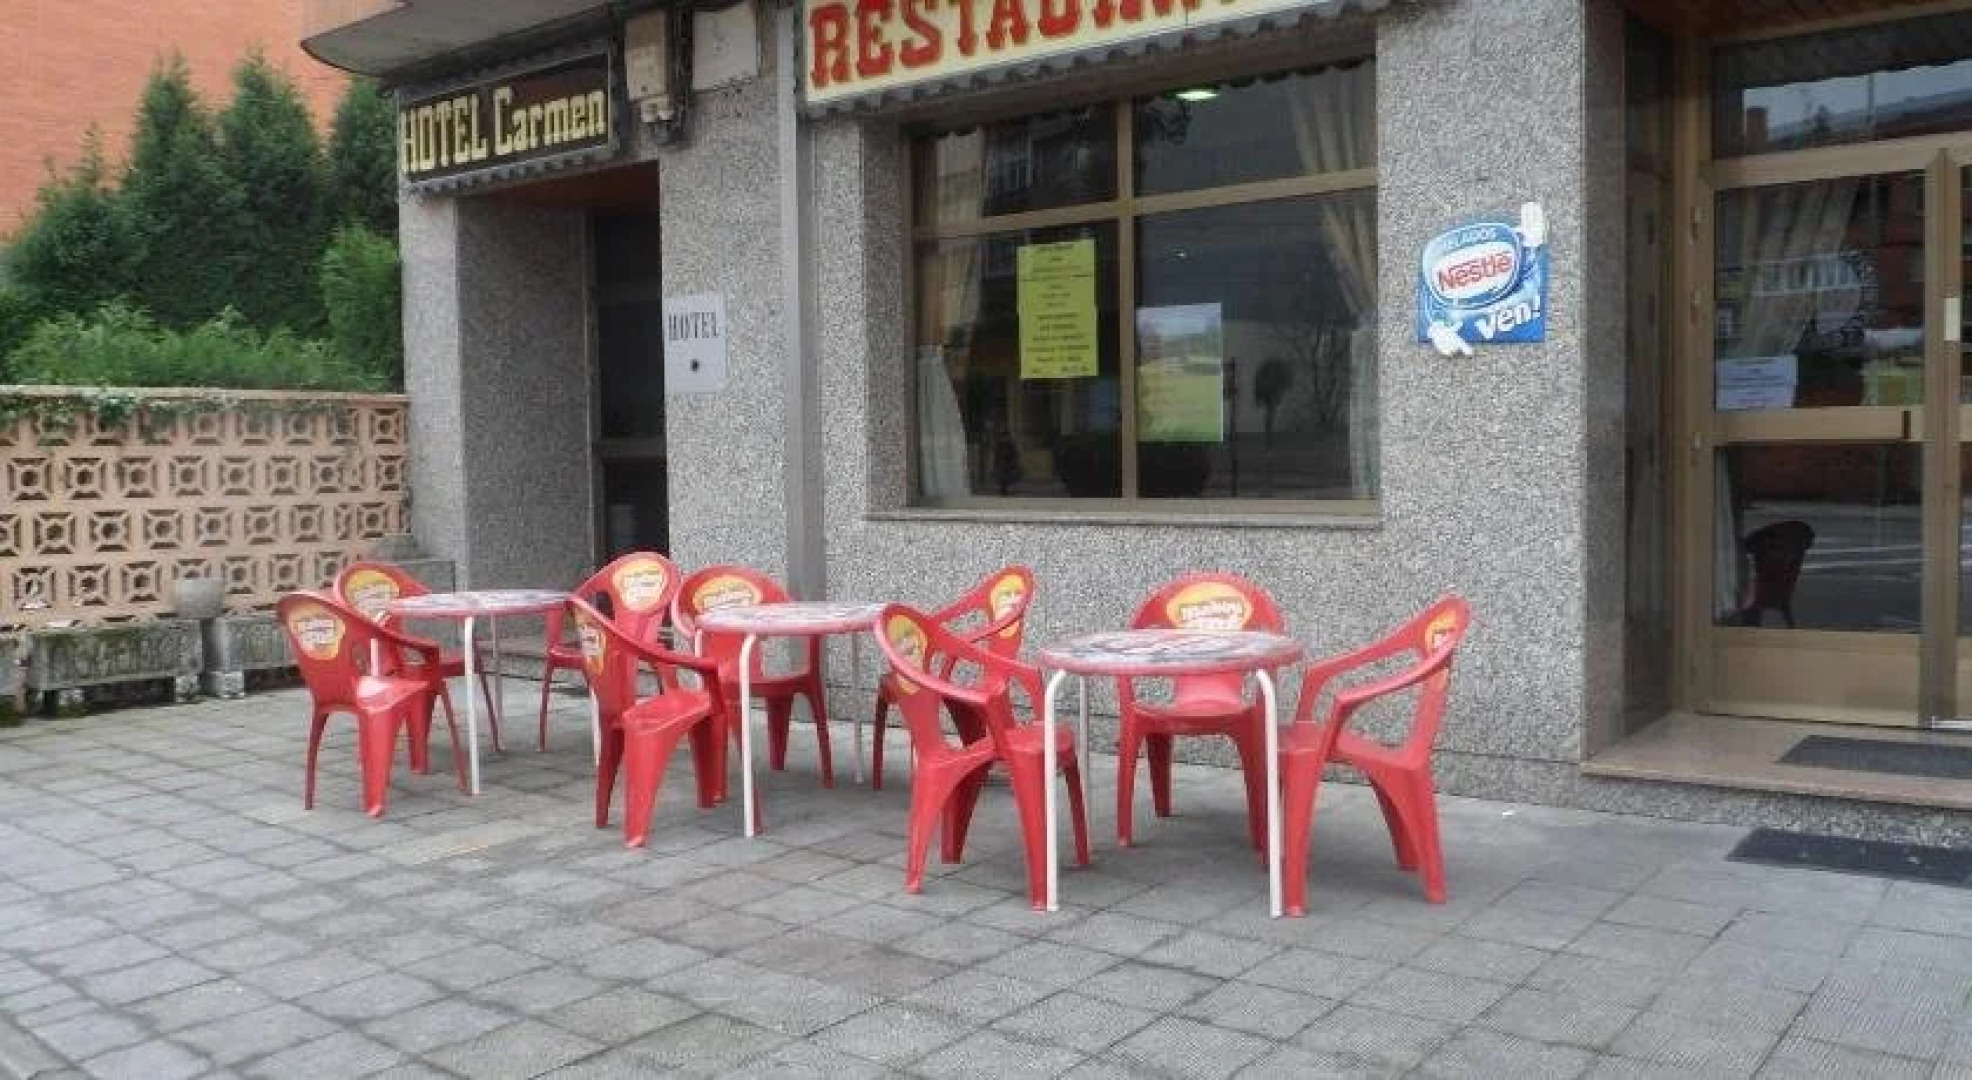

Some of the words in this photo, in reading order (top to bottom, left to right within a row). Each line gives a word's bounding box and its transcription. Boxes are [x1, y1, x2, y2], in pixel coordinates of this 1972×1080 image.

[401, 94, 487, 174] HOTEL
[493, 86, 605, 156] Carmen
[667, 311, 719, 341] HOTEL
